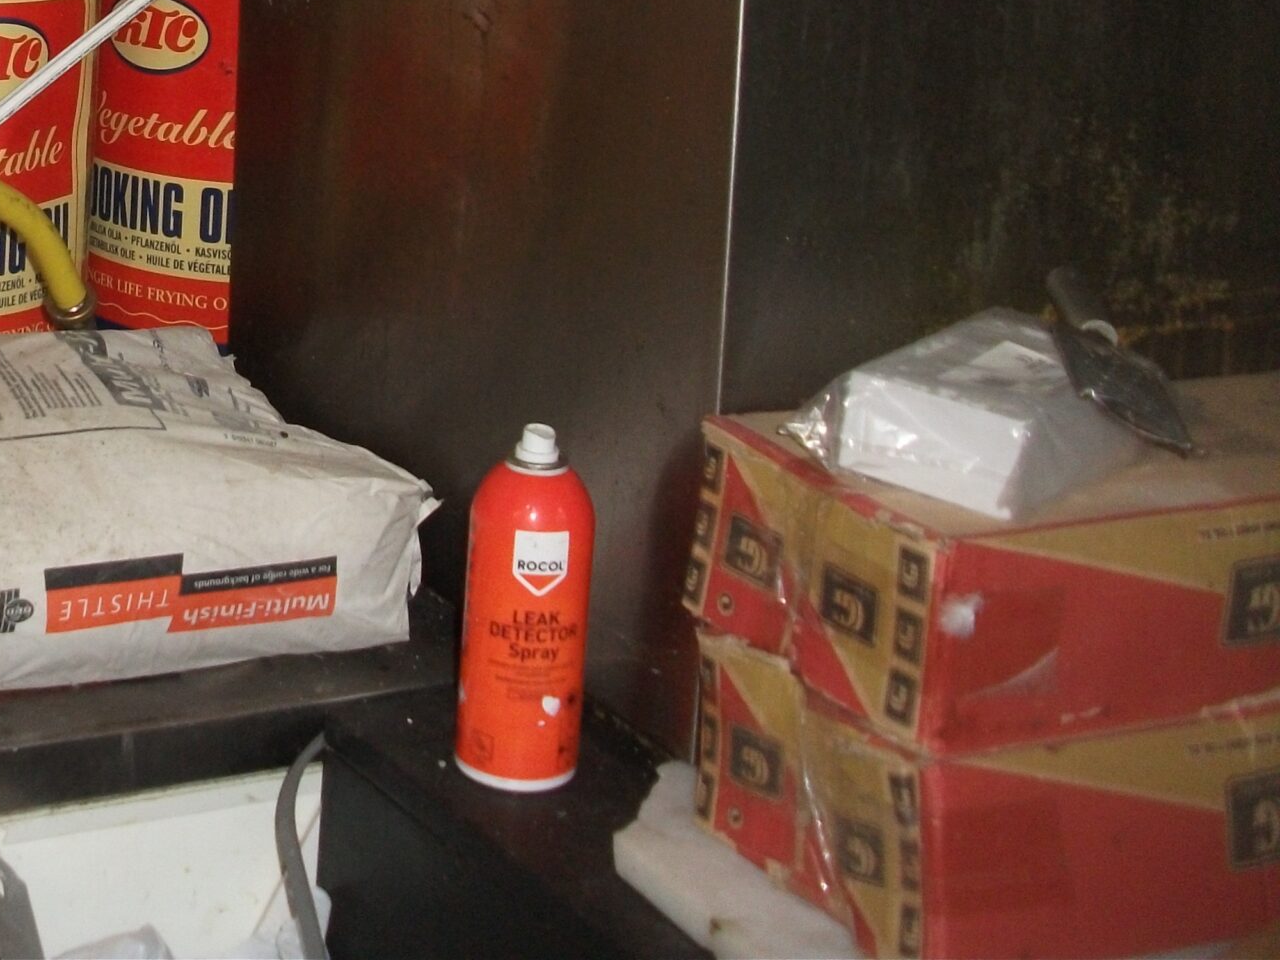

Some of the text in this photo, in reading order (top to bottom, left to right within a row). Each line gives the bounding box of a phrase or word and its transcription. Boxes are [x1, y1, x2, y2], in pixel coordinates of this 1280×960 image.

[146, 253, 170, 268] HUILE
[173, 259, 185, 271] DE
[18, 292, 28, 305] DE
[117, 278, 143, 298] LIFE
[147, 286, 208, 309] FRYING
[289, 567, 310, 578] wide
[517, 559, 564, 572] ROCOL
[194, 575, 249, 589] backgrounds
[251, 573, 261, 583] of
[58, 589, 170, 622] THISTLE
[183, 592, 330, 625] Multi-Finish
[512, 609, 560, 626] LEAK
[508, 643, 560, 662] Spray
